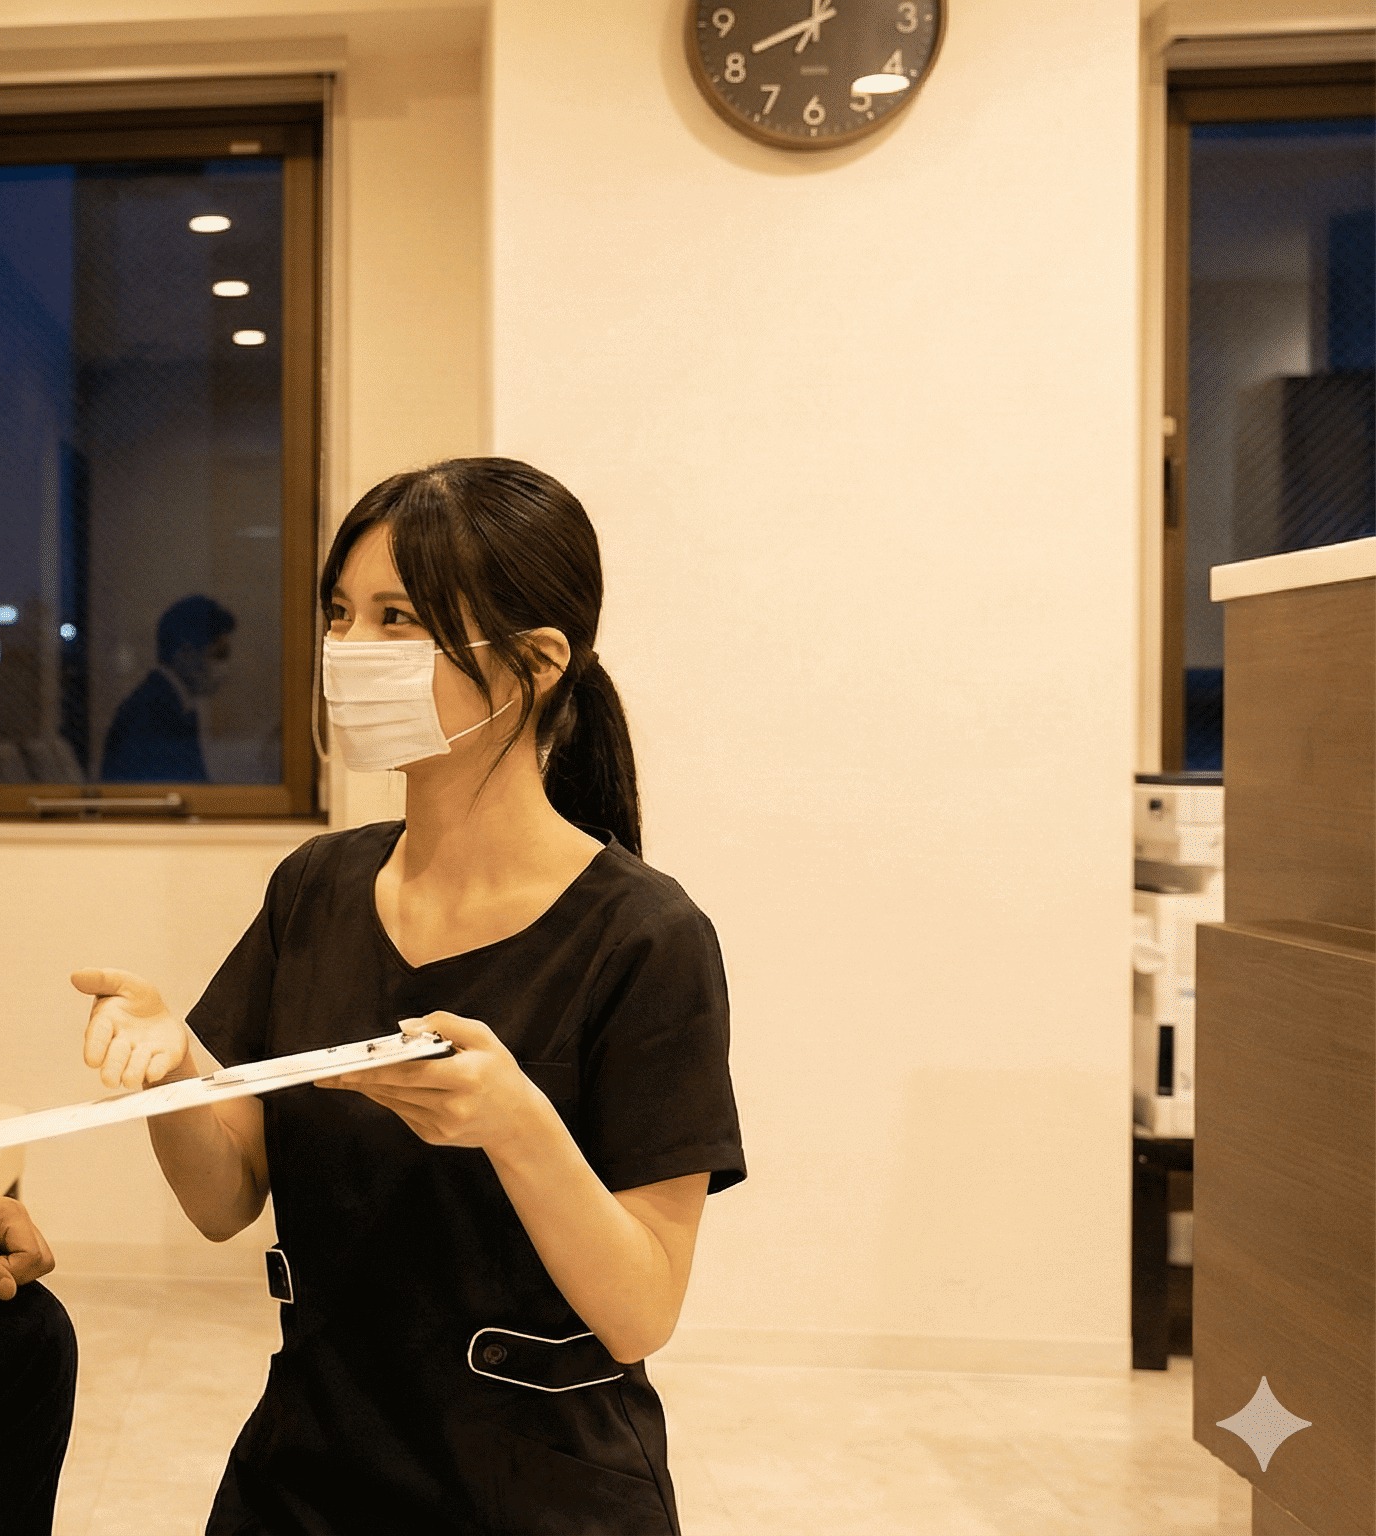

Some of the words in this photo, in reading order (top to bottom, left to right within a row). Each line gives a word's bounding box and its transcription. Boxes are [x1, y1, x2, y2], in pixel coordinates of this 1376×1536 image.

[711, 8, 735, 38] 9
[897, 2, 918, 34] 3
[724, 52, 747, 83] 8
[881, 49, 904, 75] 4
[760, 84, 781, 115] 7
[802, 96, 826, 126] 6
